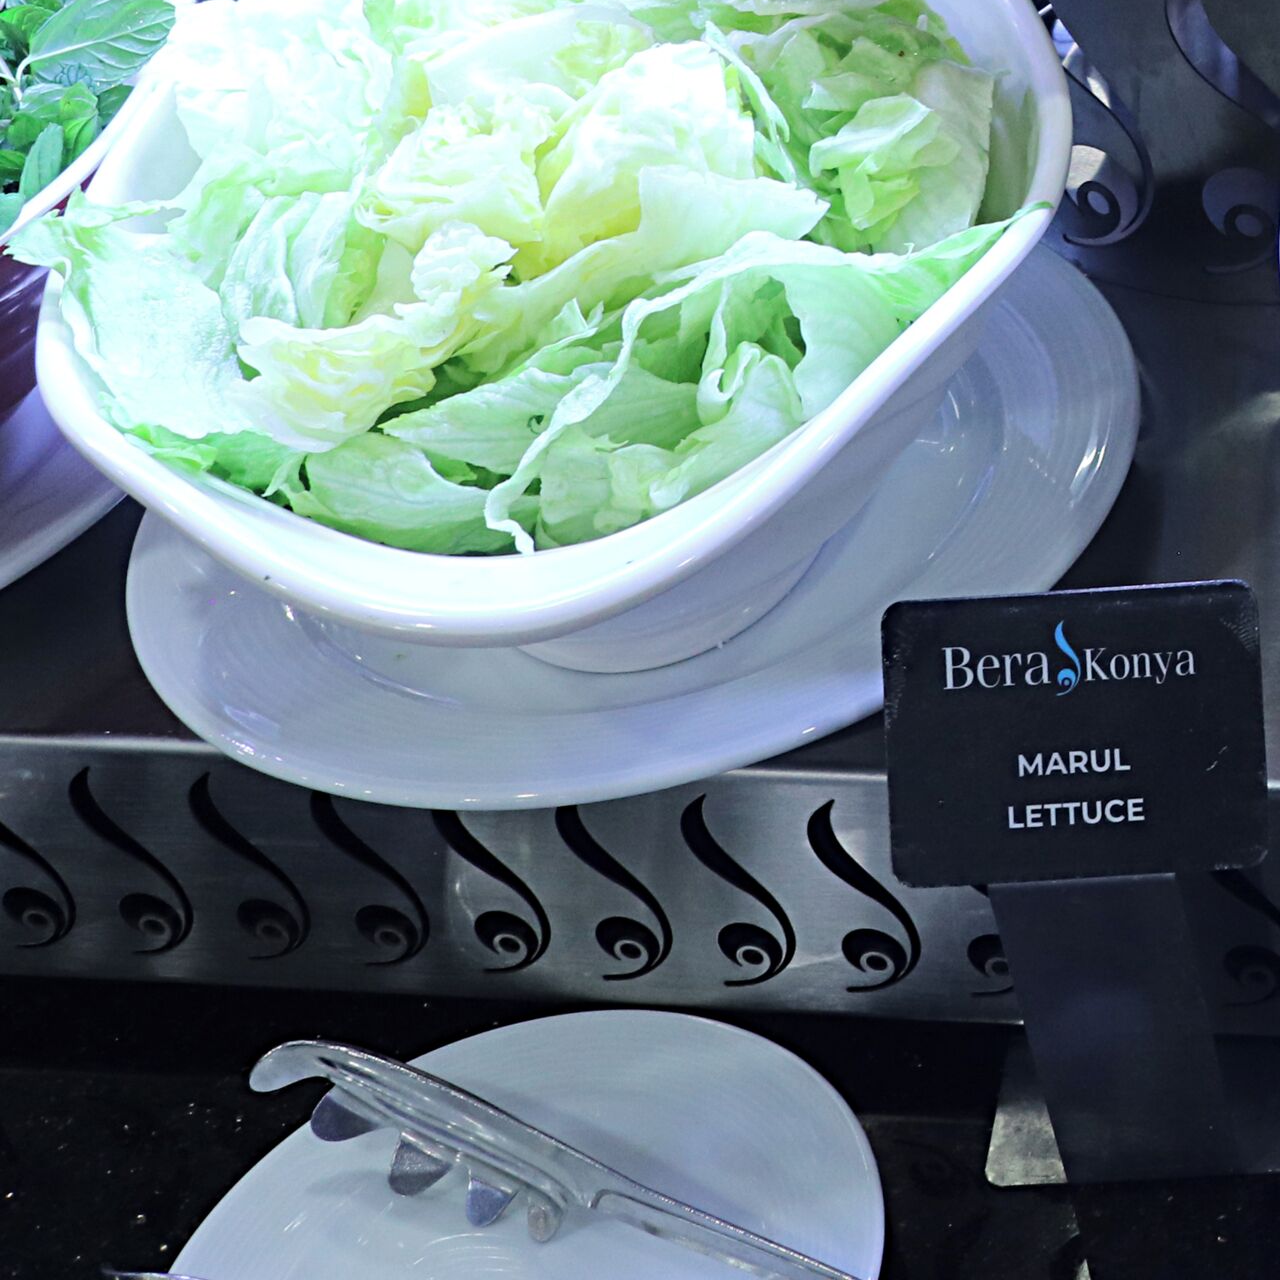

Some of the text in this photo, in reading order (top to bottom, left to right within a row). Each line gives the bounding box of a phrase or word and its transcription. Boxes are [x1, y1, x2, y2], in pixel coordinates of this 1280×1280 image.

[942, 646, 1196, 690] Bera Konya
[1017, 748, 1131, 777] MARUL
[1007, 798, 1145, 829] LETTUCE
